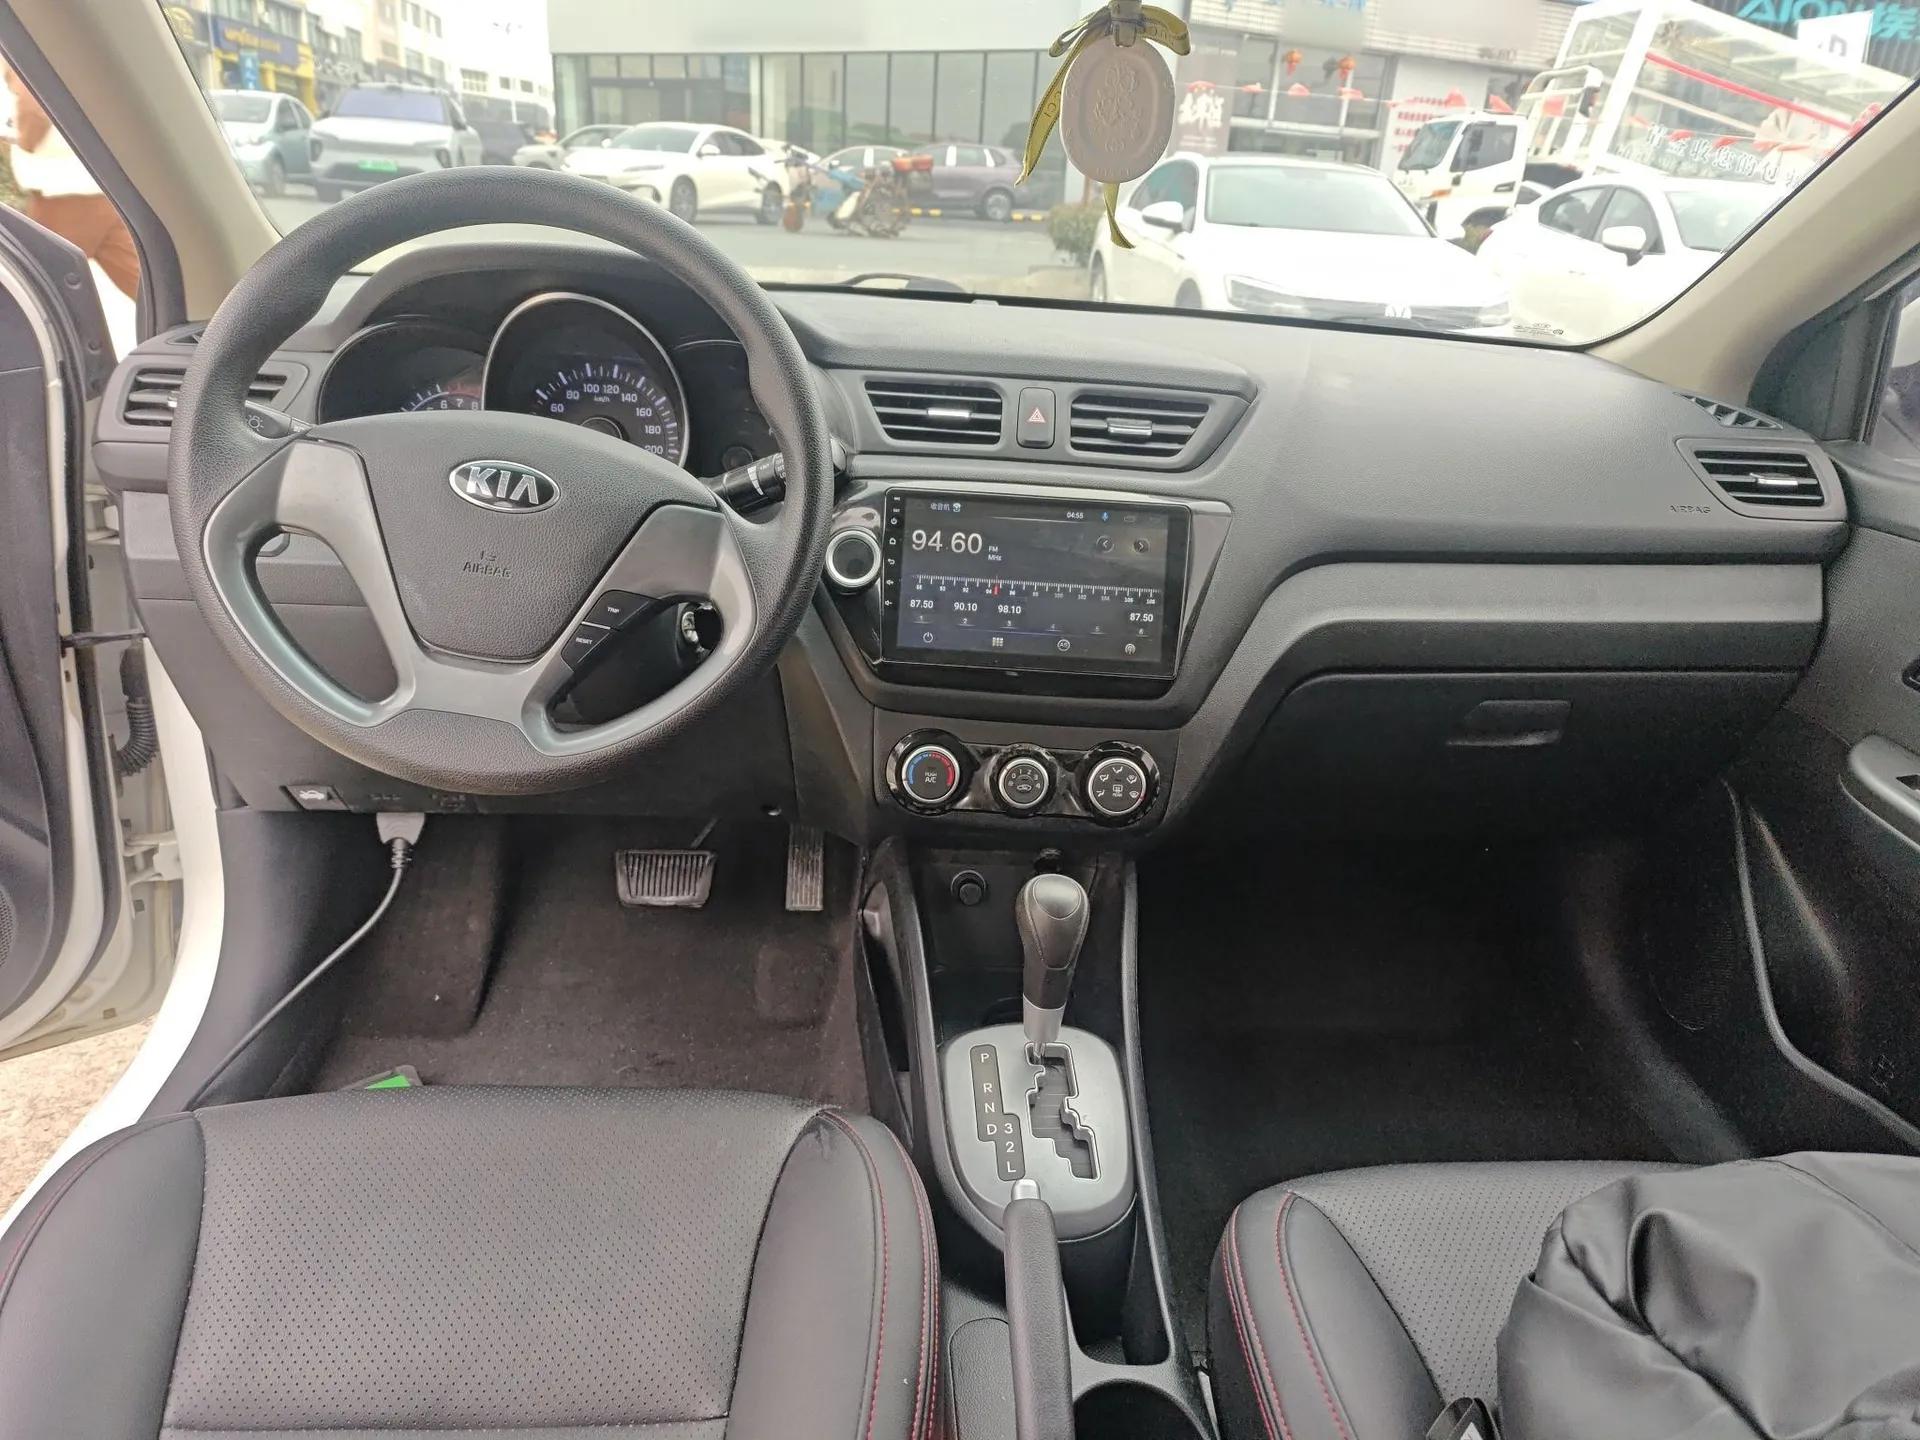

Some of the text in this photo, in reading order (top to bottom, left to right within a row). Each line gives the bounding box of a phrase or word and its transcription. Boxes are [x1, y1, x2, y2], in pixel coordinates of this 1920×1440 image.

[583, 383, 620, 395] 100 120
[566, 390, 580, 400] 80
[621, 393, 638, 403] 140
[440, 399, 448, 409] 6
[456, 398, 464, 408] 7
[471, 401, 479, 411] 8
[550, 403, 564, 413] 60
[636, 407, 653, 417] 160
[644, 424, 661, 435] 180
[644, 445, 664, 455] 200
[466, 465, 539, 505] KIA
[911, 529, 983, 554] 94.60
[988, 545, 998, 553] FM
[463, 561, 511, 578] AIRBAG
[910, 600, 1153, 622] 87.50 90.10 98.10 87.50
[980, 1053, 990, 1063] P
[983, 1082, 993, 1093] R
[984, 1102, 995, 1113] N
[986, 1123, 1013, 1136] D 3
[1005, 1141, 1015, 1153] 2
[1006, 1161, 1017, 1173] L
